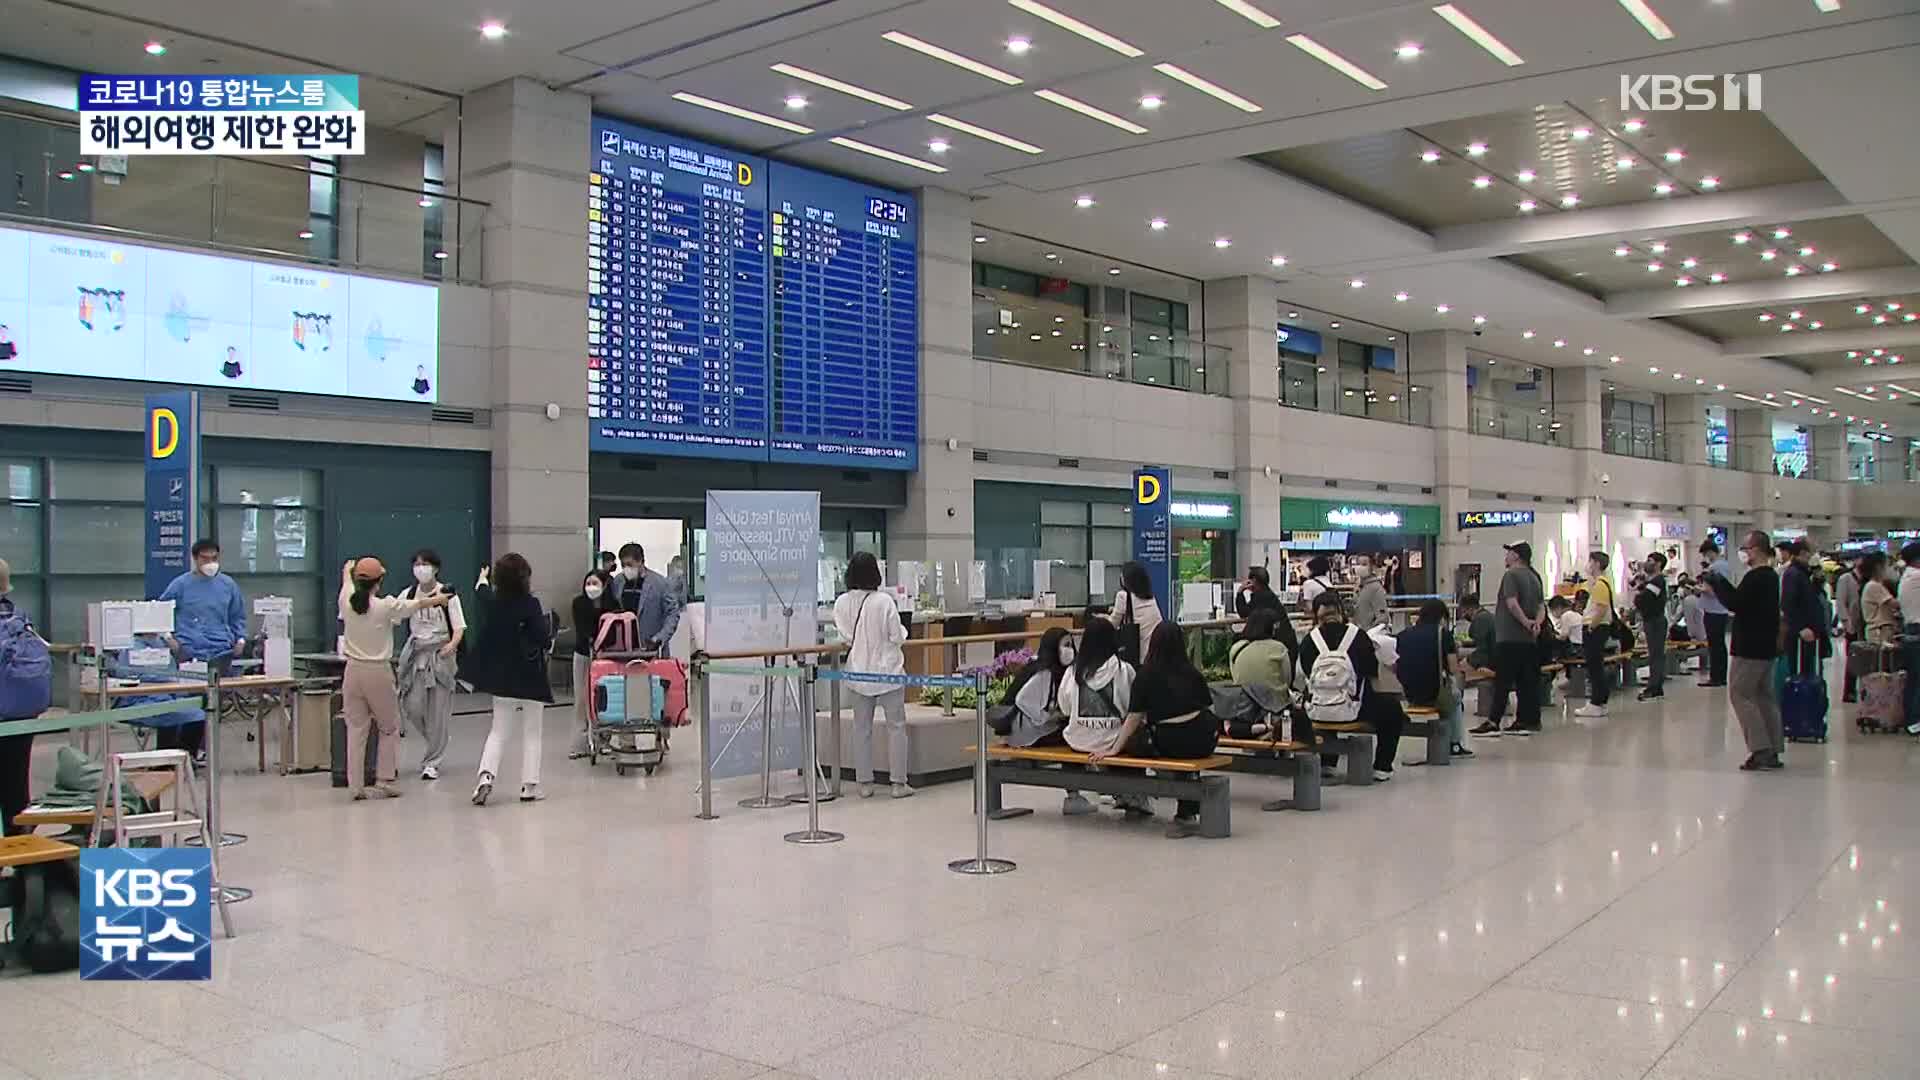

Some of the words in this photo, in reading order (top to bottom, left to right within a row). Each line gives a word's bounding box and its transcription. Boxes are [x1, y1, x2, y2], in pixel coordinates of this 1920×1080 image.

[738, 163, 753, 186] D
[870, 199, 907, 222] 12:34
[151, 407, 179, 459] D
[1138, 475, 1161, 504] D
